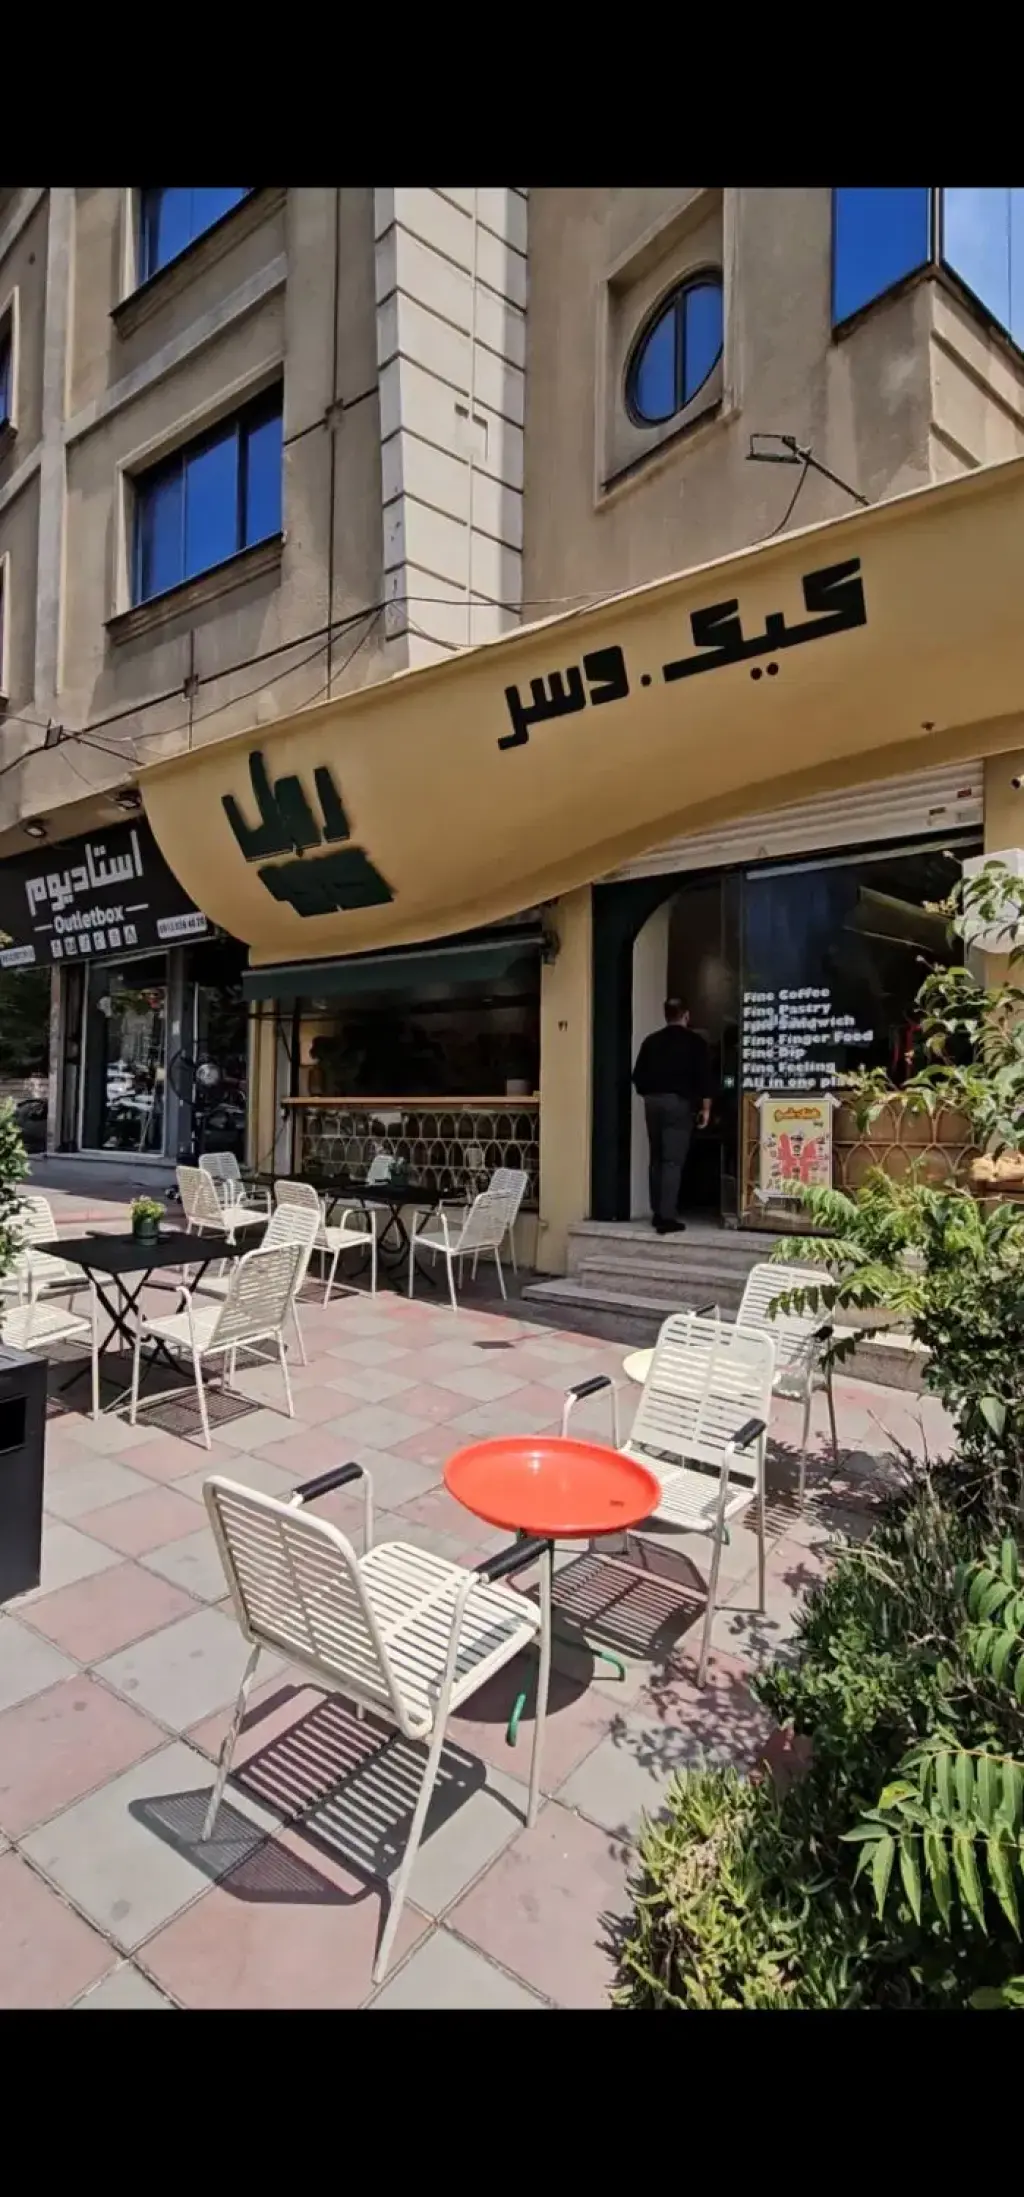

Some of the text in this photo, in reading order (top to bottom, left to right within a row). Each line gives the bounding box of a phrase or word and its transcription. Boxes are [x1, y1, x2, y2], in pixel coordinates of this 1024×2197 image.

[662, 557, 867, 683] کیک
[25, 829, 143, 917] استادیوم
[54, 905, 125, 933] Outletbox
[744, 987, 830, 1002] Fine Coffee
[744, 1003, 832, 1017] Fine Pastry
[744, 1029, 874, 1045] Fine Finger Food
[743, 1047, 806, 1058] Fine Dip
[743, 1061, 836, 1073] Fine Feeling
[769, 1077, 784, 1087] in
[788, 1078, 816, 1087] one
